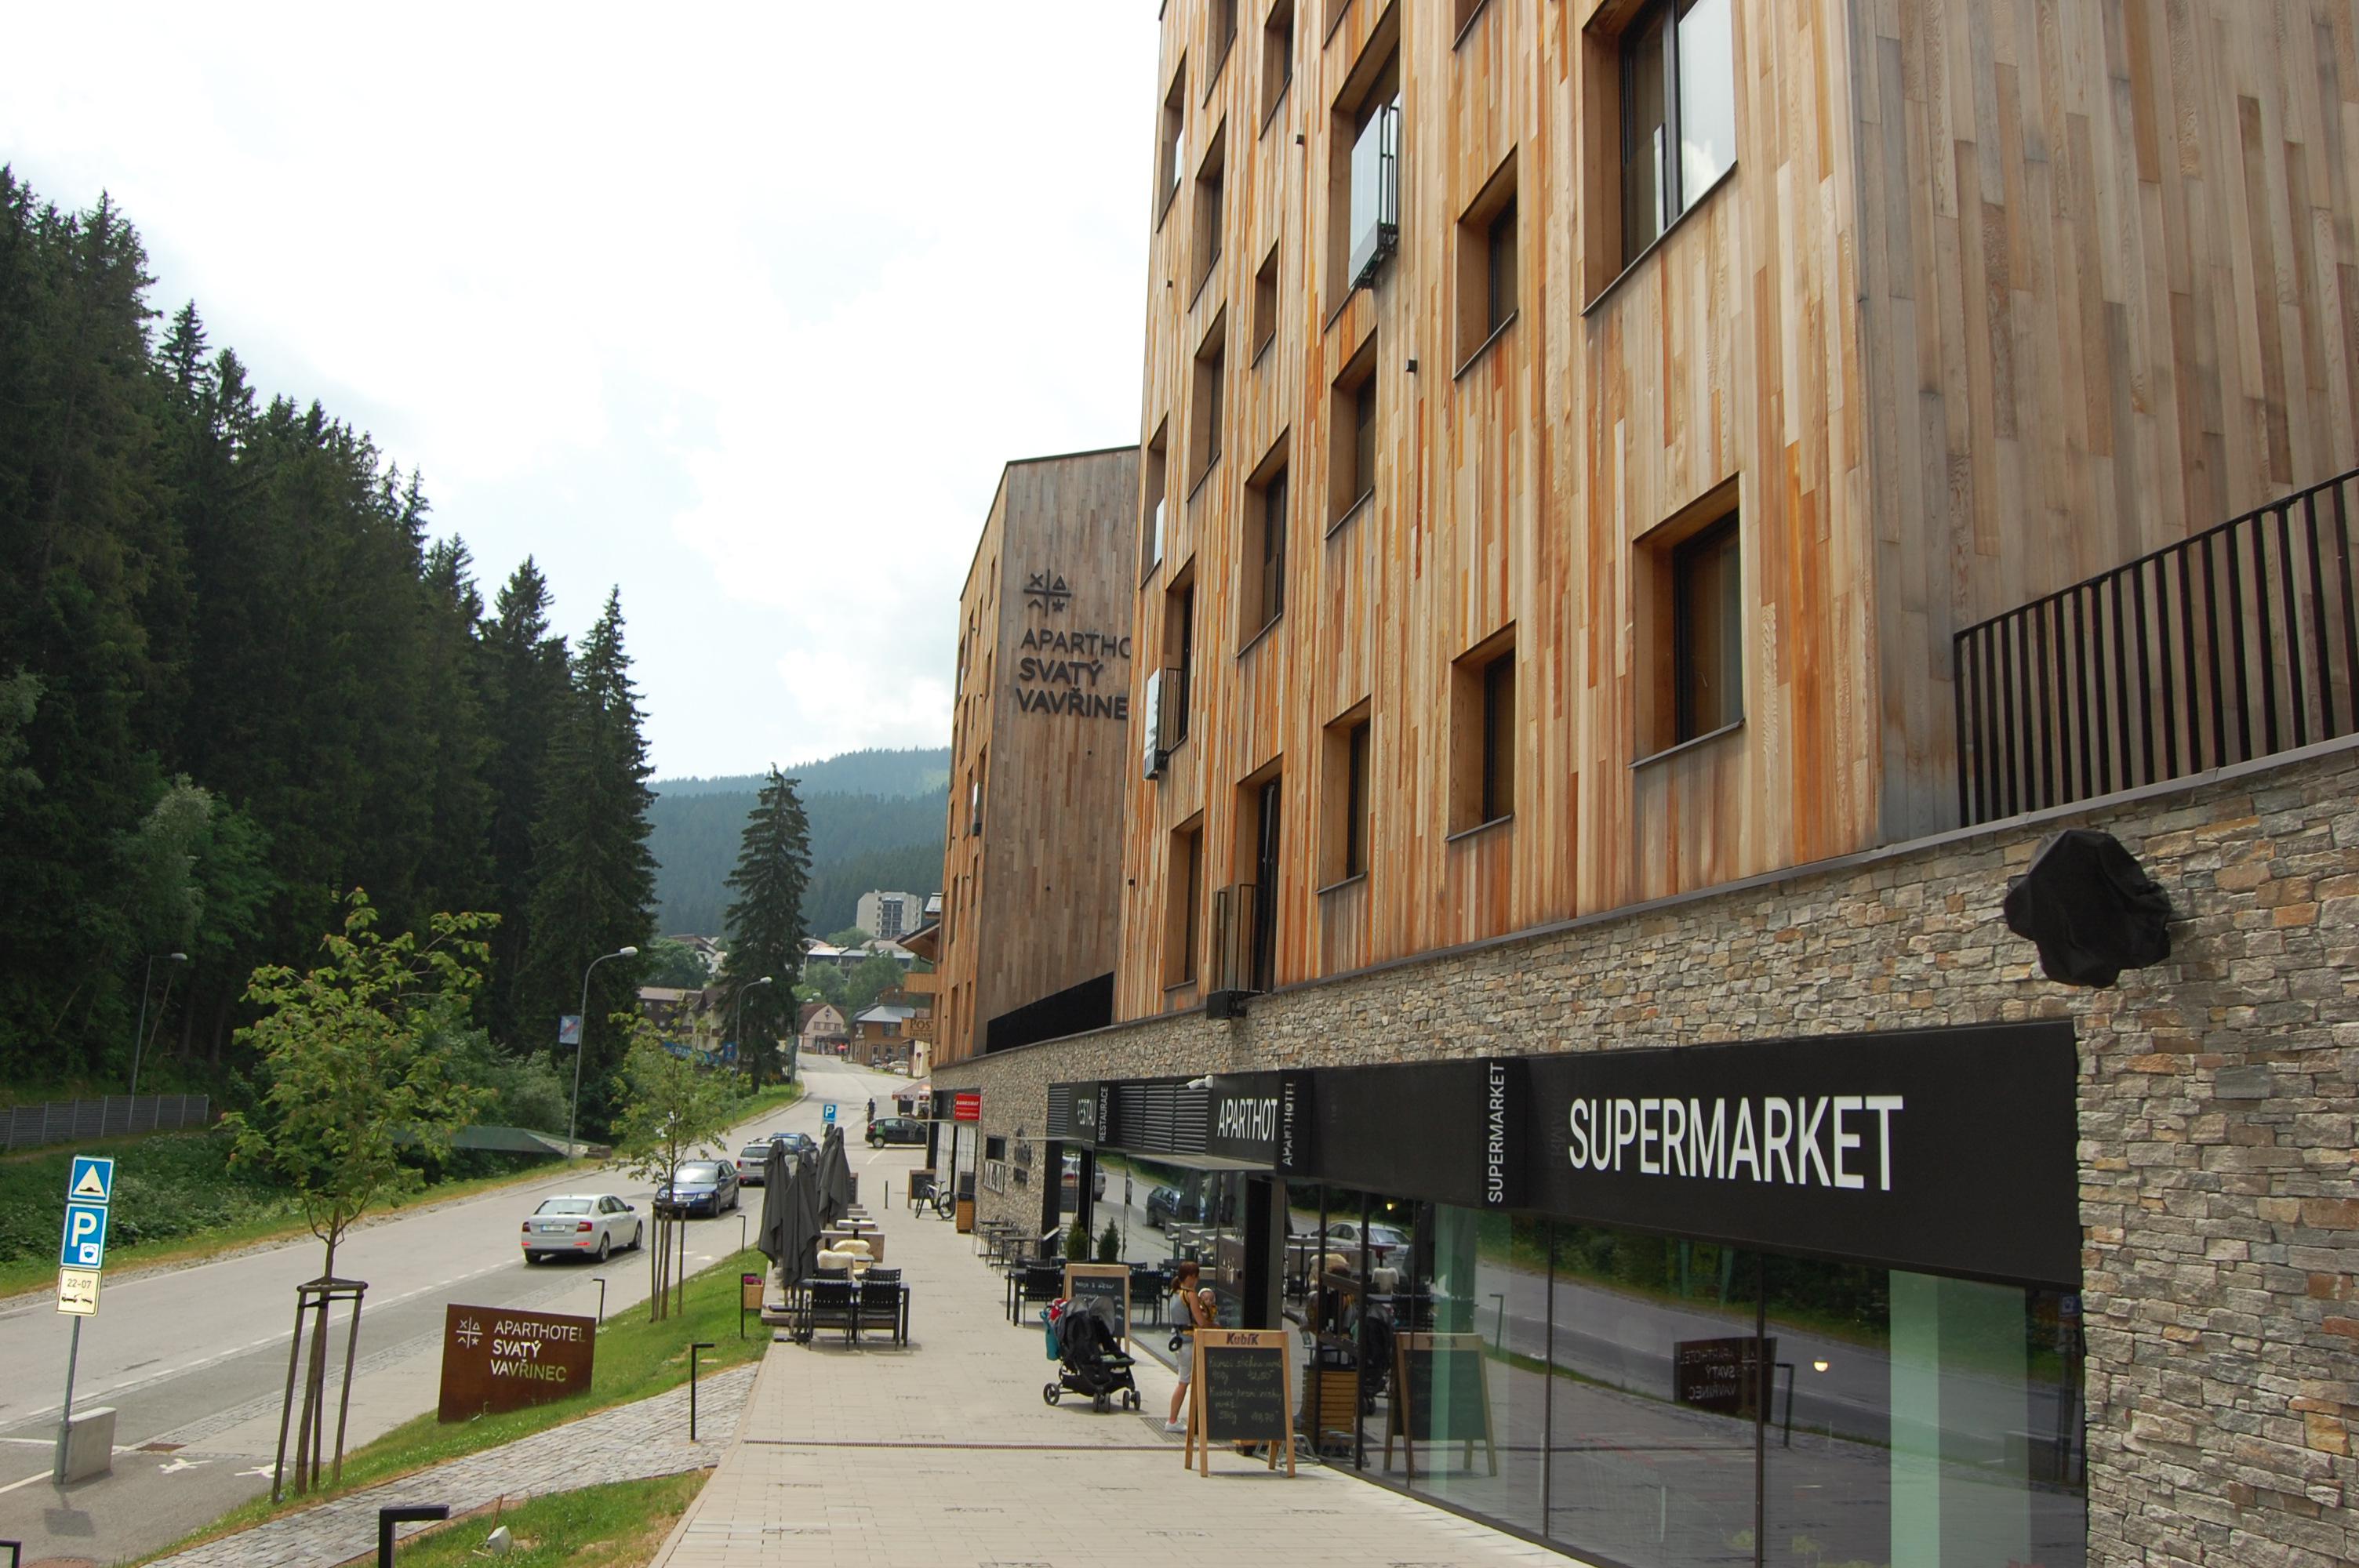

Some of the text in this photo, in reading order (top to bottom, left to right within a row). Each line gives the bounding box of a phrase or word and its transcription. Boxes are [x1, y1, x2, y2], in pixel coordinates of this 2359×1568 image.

[1020, 628, 1130, 659] APARTHO
[1019, 657, 1104, 687] SVATÝ
[1016, 687, 1128, 720] VAVŘINE
[825, 1105, 834, 1117] P
[1099, 1087, 1109, 1142] RESTAURACE
[1217, 1098, 1278, 1142] APARTHOT
[1282, 1081, 1296, 1167] APARTHOTEL
[1488, 1062, 1505, 1203] SUPERMARKET
[1569, 1095, 1903, 1191] SUPERMARKET
[71, 1211, 97, 1247] P
[67, 1278, 93, 1290] 22-07
[494, 1319, 586, 1342] APARTHOTEL
[493, 1339, 542, 1358] SVATÝ
[490, 1359, 567, 1382] VAVŘINEC
